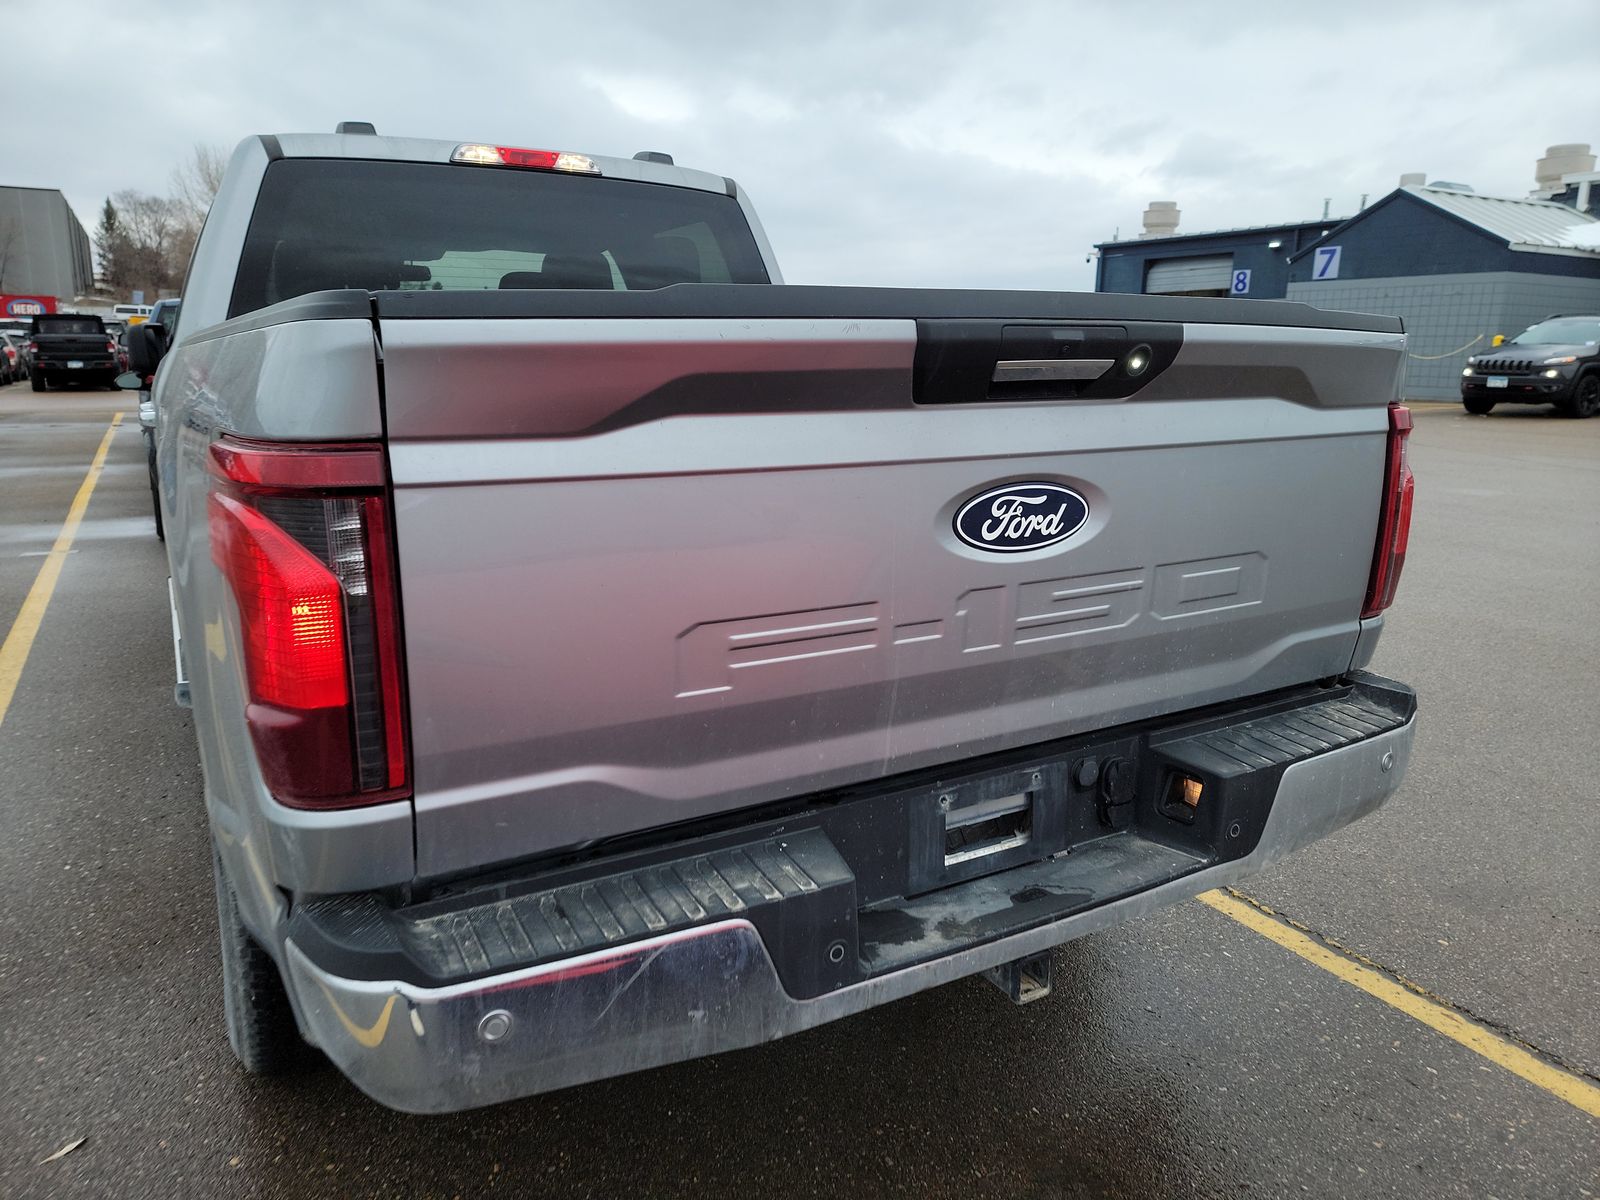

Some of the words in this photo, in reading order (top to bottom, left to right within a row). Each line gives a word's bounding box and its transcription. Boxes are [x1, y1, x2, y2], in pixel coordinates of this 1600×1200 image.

[1318, 248, 1337, 278] 7
[1234, 271, 1247, 292] 8
[12, 303, 41, 315] HERO
[981, 495, 1068, 541] Ford
[675, 551, 1269, 699] F-150
